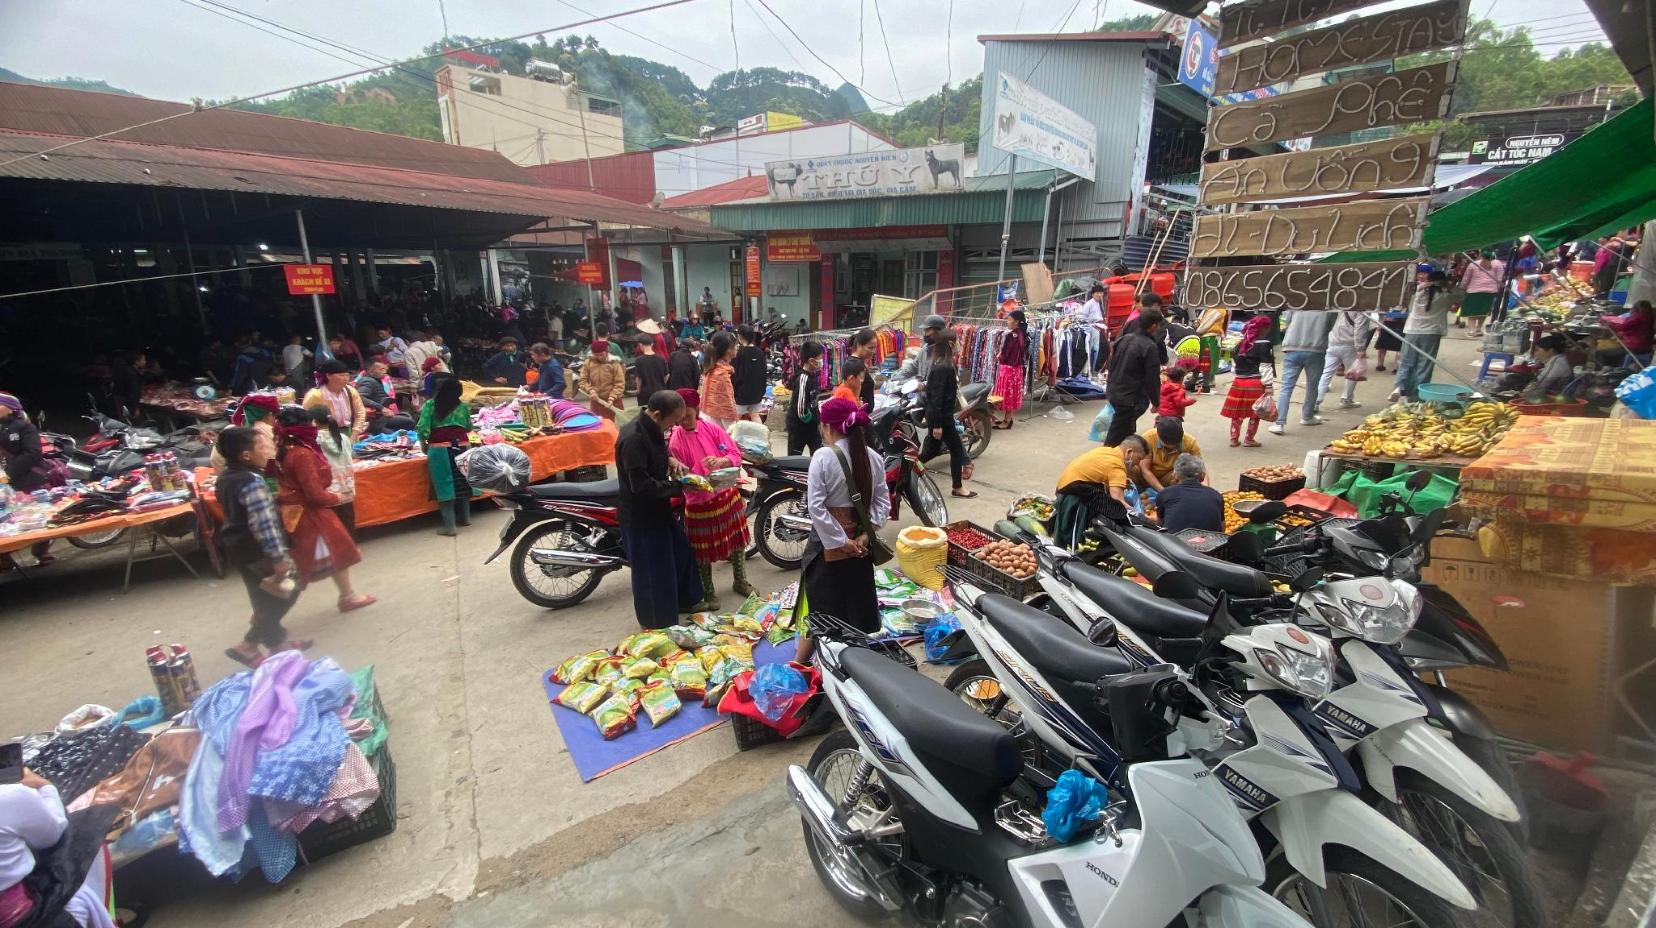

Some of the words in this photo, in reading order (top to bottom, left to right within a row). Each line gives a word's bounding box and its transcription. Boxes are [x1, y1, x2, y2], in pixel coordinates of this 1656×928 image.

[1508, 147, 1526, 159] TÓC
[801, 165, 880, 190] THÚ
[891, 165, 921, 184] Y
[1185, 267, 1408, 311] 0865654841
[1325, 704, 1367, 733] YAMAHA
[1224, 768, 1267, 804] YAMAHA
[1086, 861, 1120, 888] HOND
